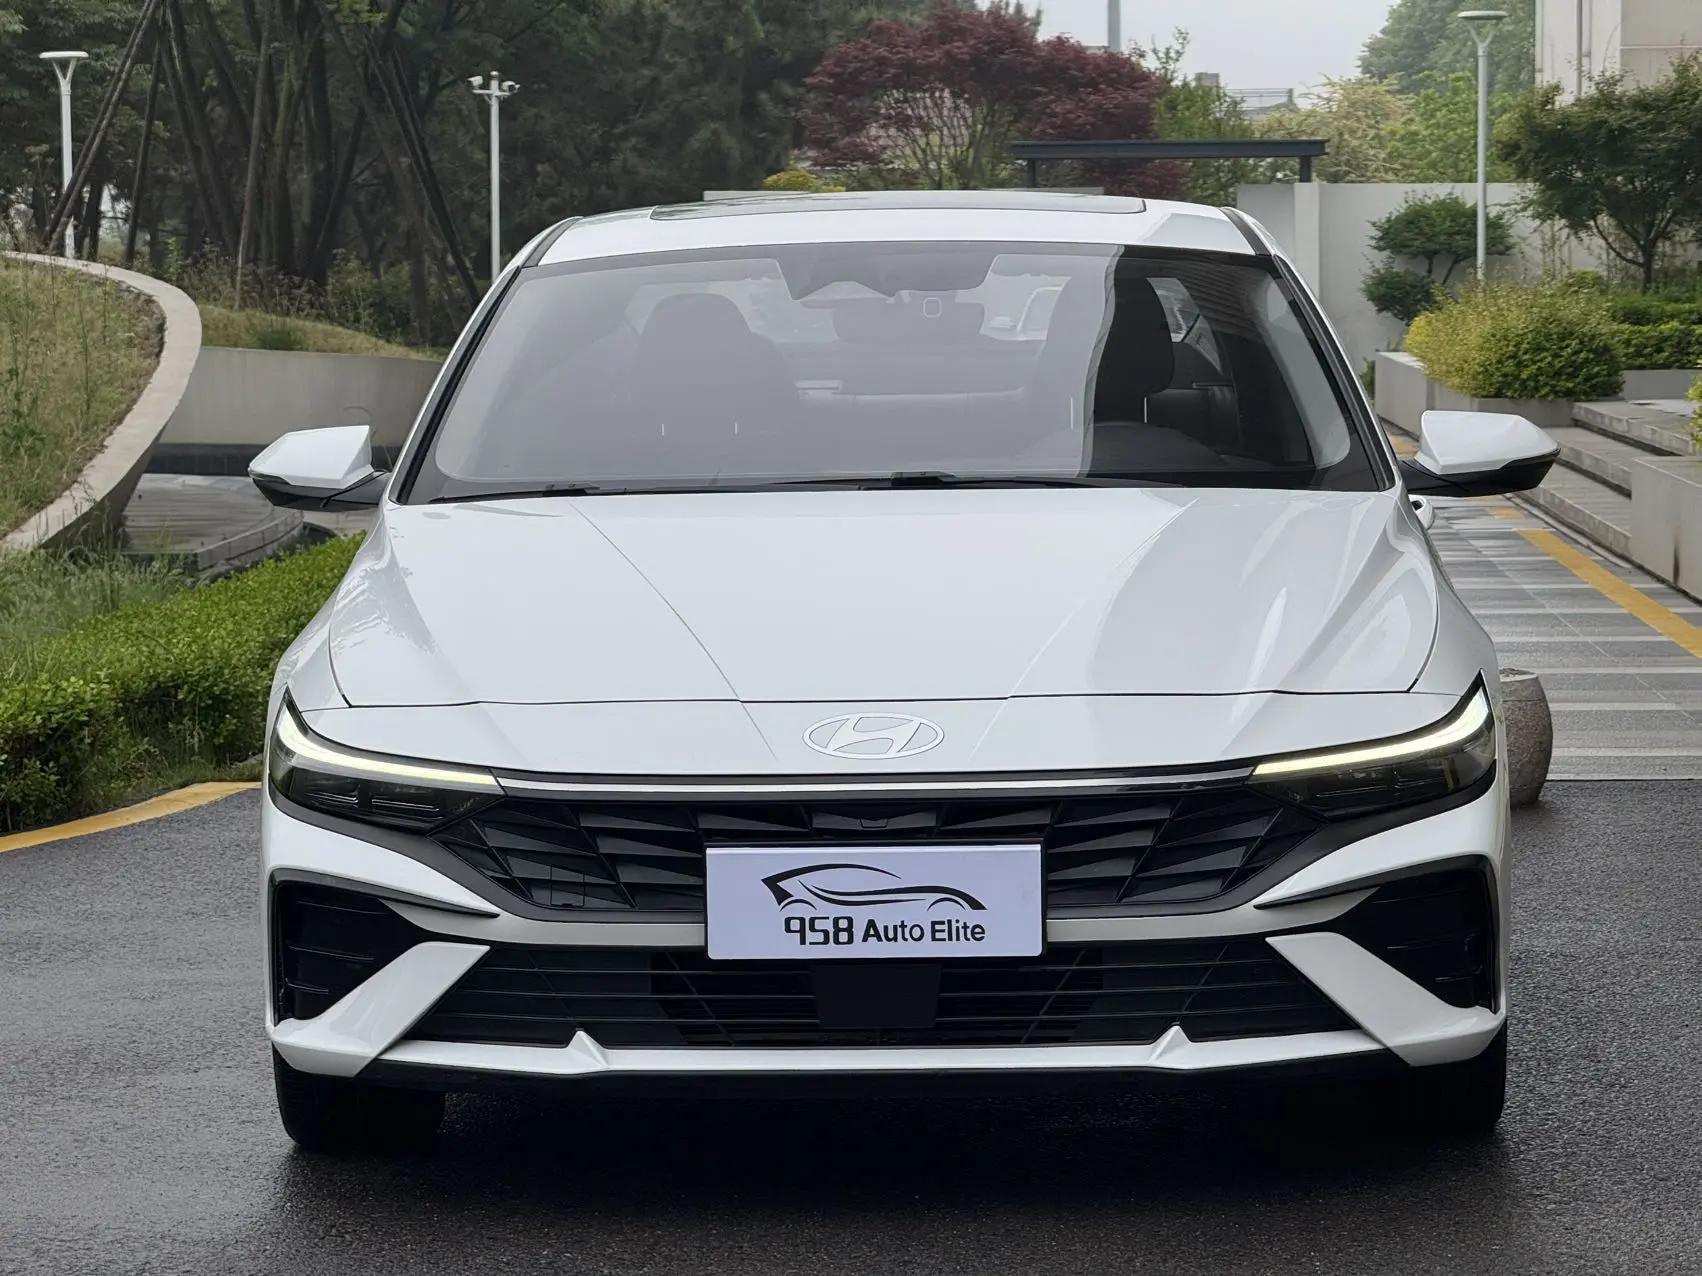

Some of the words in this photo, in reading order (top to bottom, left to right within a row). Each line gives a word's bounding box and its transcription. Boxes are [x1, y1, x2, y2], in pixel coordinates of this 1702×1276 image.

[784, 916, 854, 945] 958
[861, 919, 925, 942] Auto
[931, 919, 986, 942] Elite
